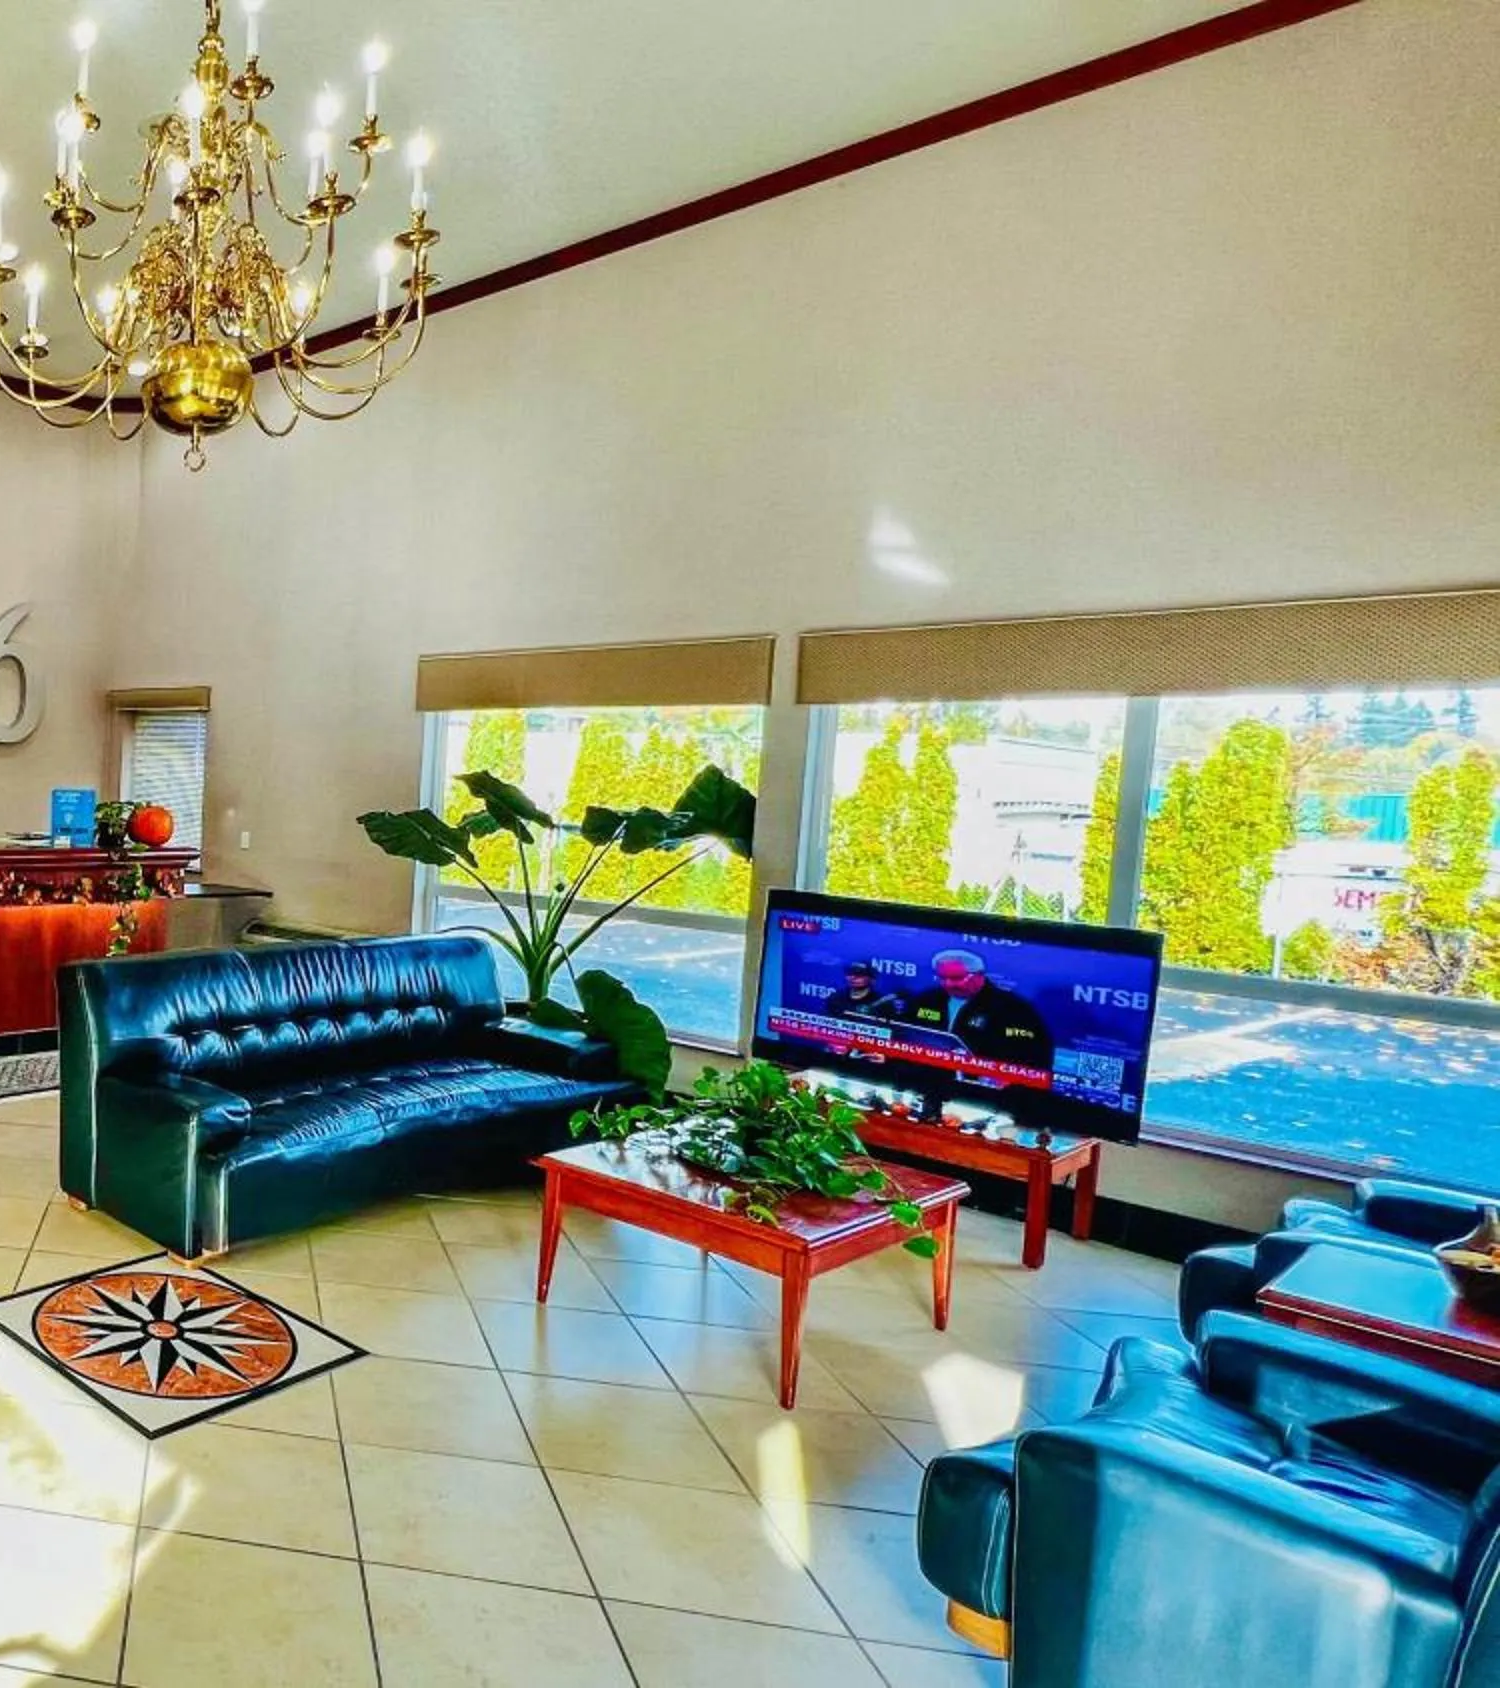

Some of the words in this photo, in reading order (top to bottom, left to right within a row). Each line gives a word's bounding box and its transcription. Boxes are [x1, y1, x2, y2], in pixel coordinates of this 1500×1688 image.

[782, 919, 814, 932] LIVE
[871, 957, 918, 977] NTSB
[1072, 984, 1150, 1011] NTSB
[857, 1034, 875, 1045] ON
[877, 1039, 923, 1056] DEADLY
[925, 1049, 951, 1061] UPS
[953, 1055, 997, 1072] PLANE
[999, 1063, 1048, 1082] CRASH
